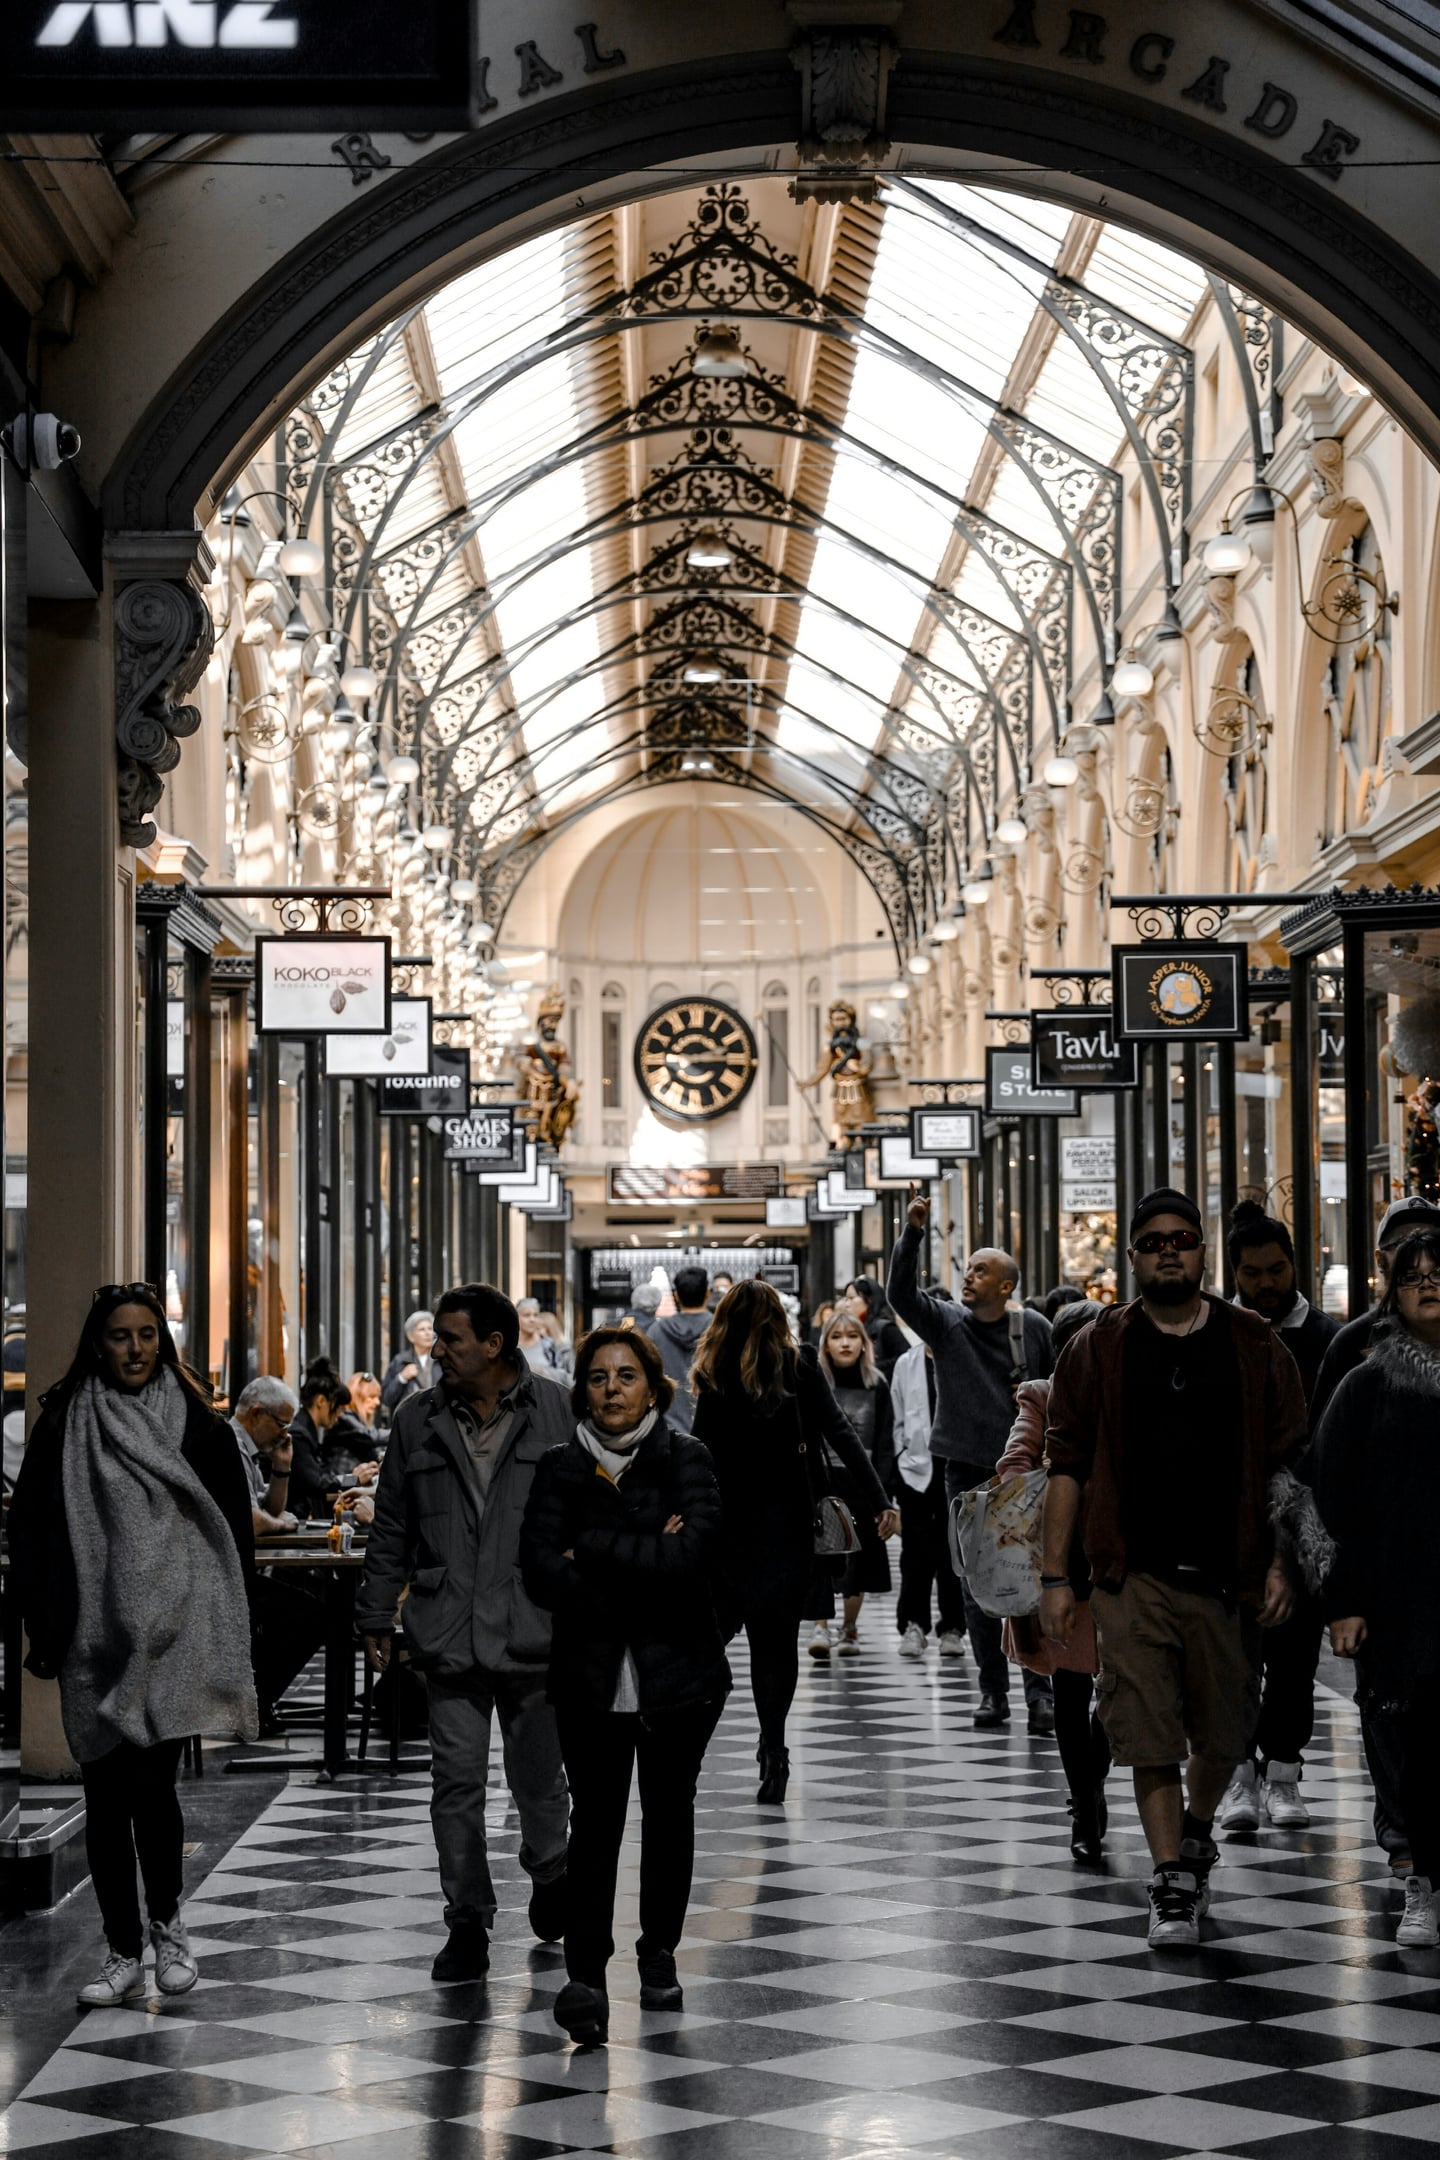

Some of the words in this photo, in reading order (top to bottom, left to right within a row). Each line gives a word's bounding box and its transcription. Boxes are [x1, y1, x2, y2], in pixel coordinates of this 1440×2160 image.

[331, 23, 626, 187] RAL
[992, 0, 1360, 181] ARCADE
[274, 967, 331, 982] KOKO
[331, 967, 372, 977] BLACK
[1147, 961, 1178, 995] JASPER
[1179, 961, 1213, 995] JUNIOR
[392, 1021, 418, 1031] ACK
[385, 1074, 462, 1089] roxanne
[444, 1118, 511, 1136] GAMES
[453, 1133, 503, 1149] SHOP
